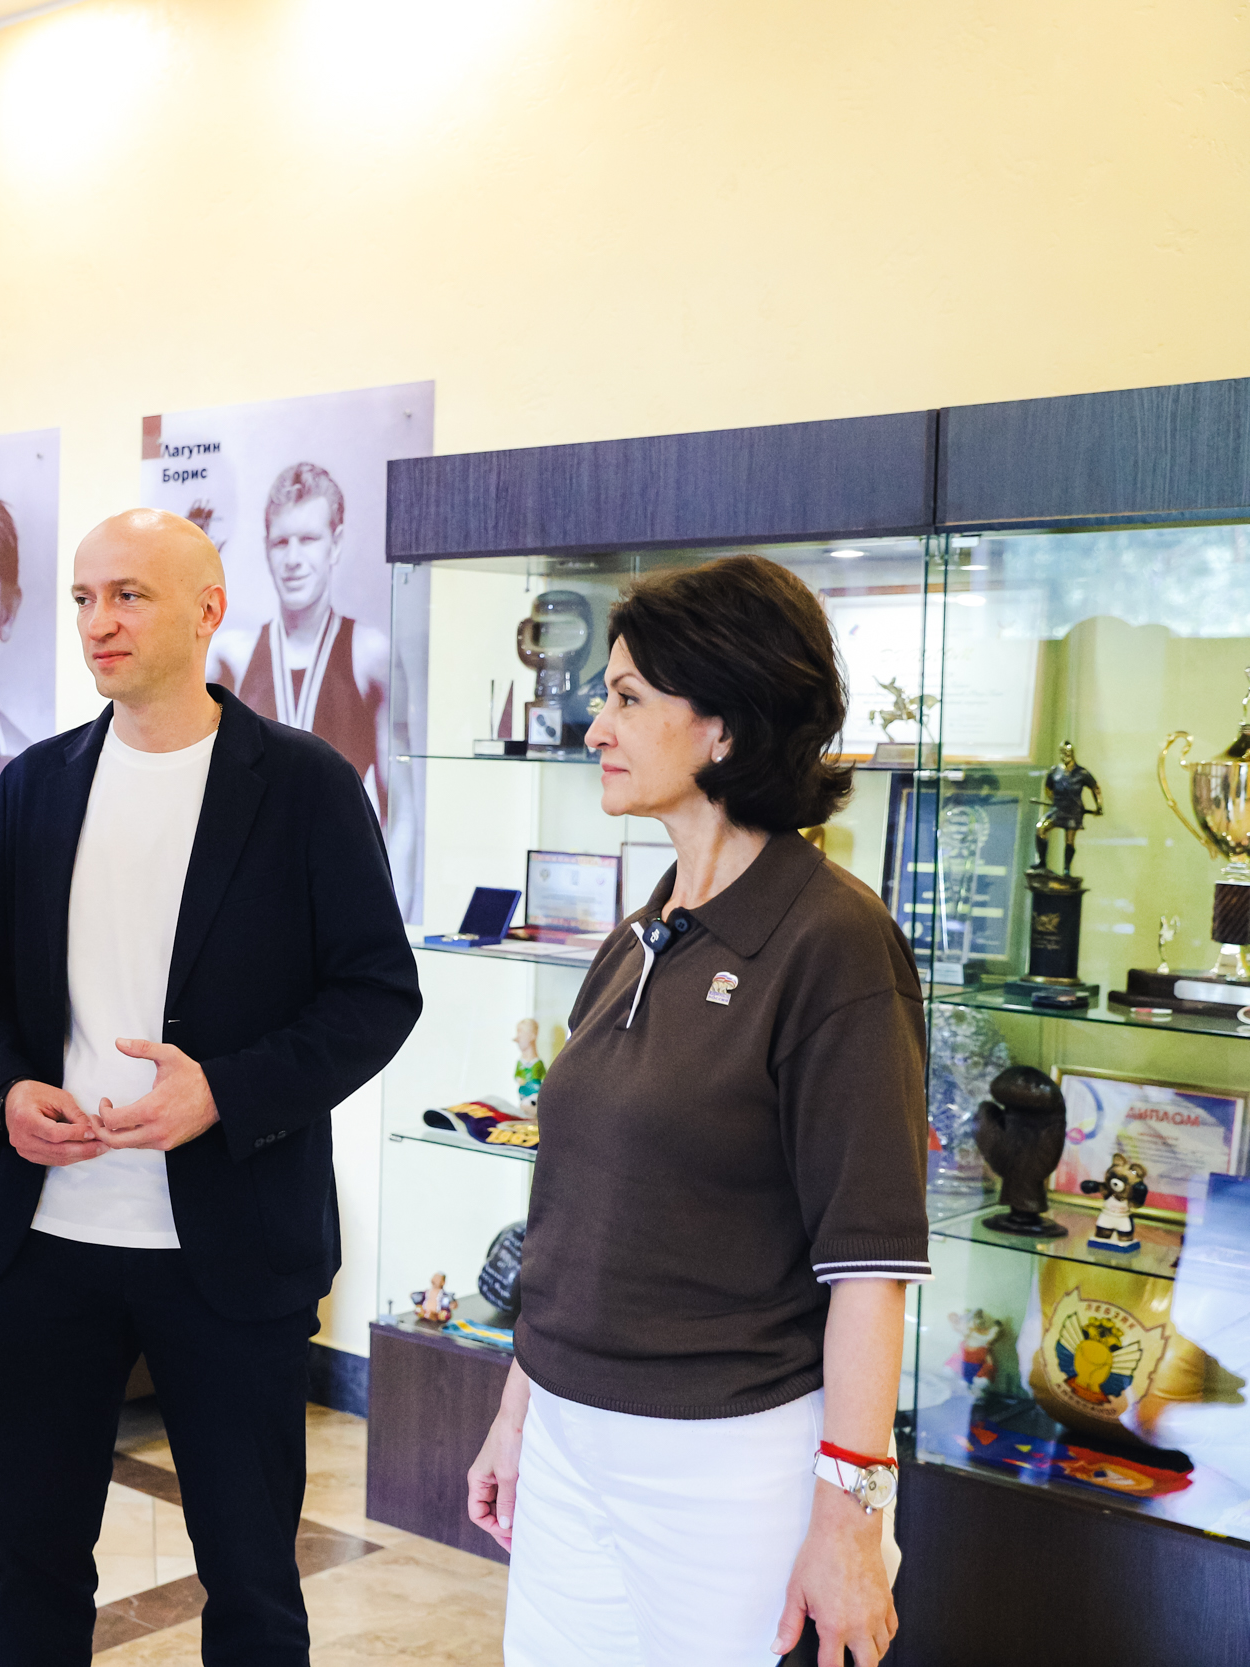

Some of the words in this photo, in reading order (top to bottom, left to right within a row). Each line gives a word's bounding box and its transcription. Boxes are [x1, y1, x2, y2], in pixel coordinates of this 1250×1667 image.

[161, 442, 221, 460] Лагутин
[162, 468, 208, 484] Борис
[1125, 1106, 1201, 1128] ДИПЛОМ
